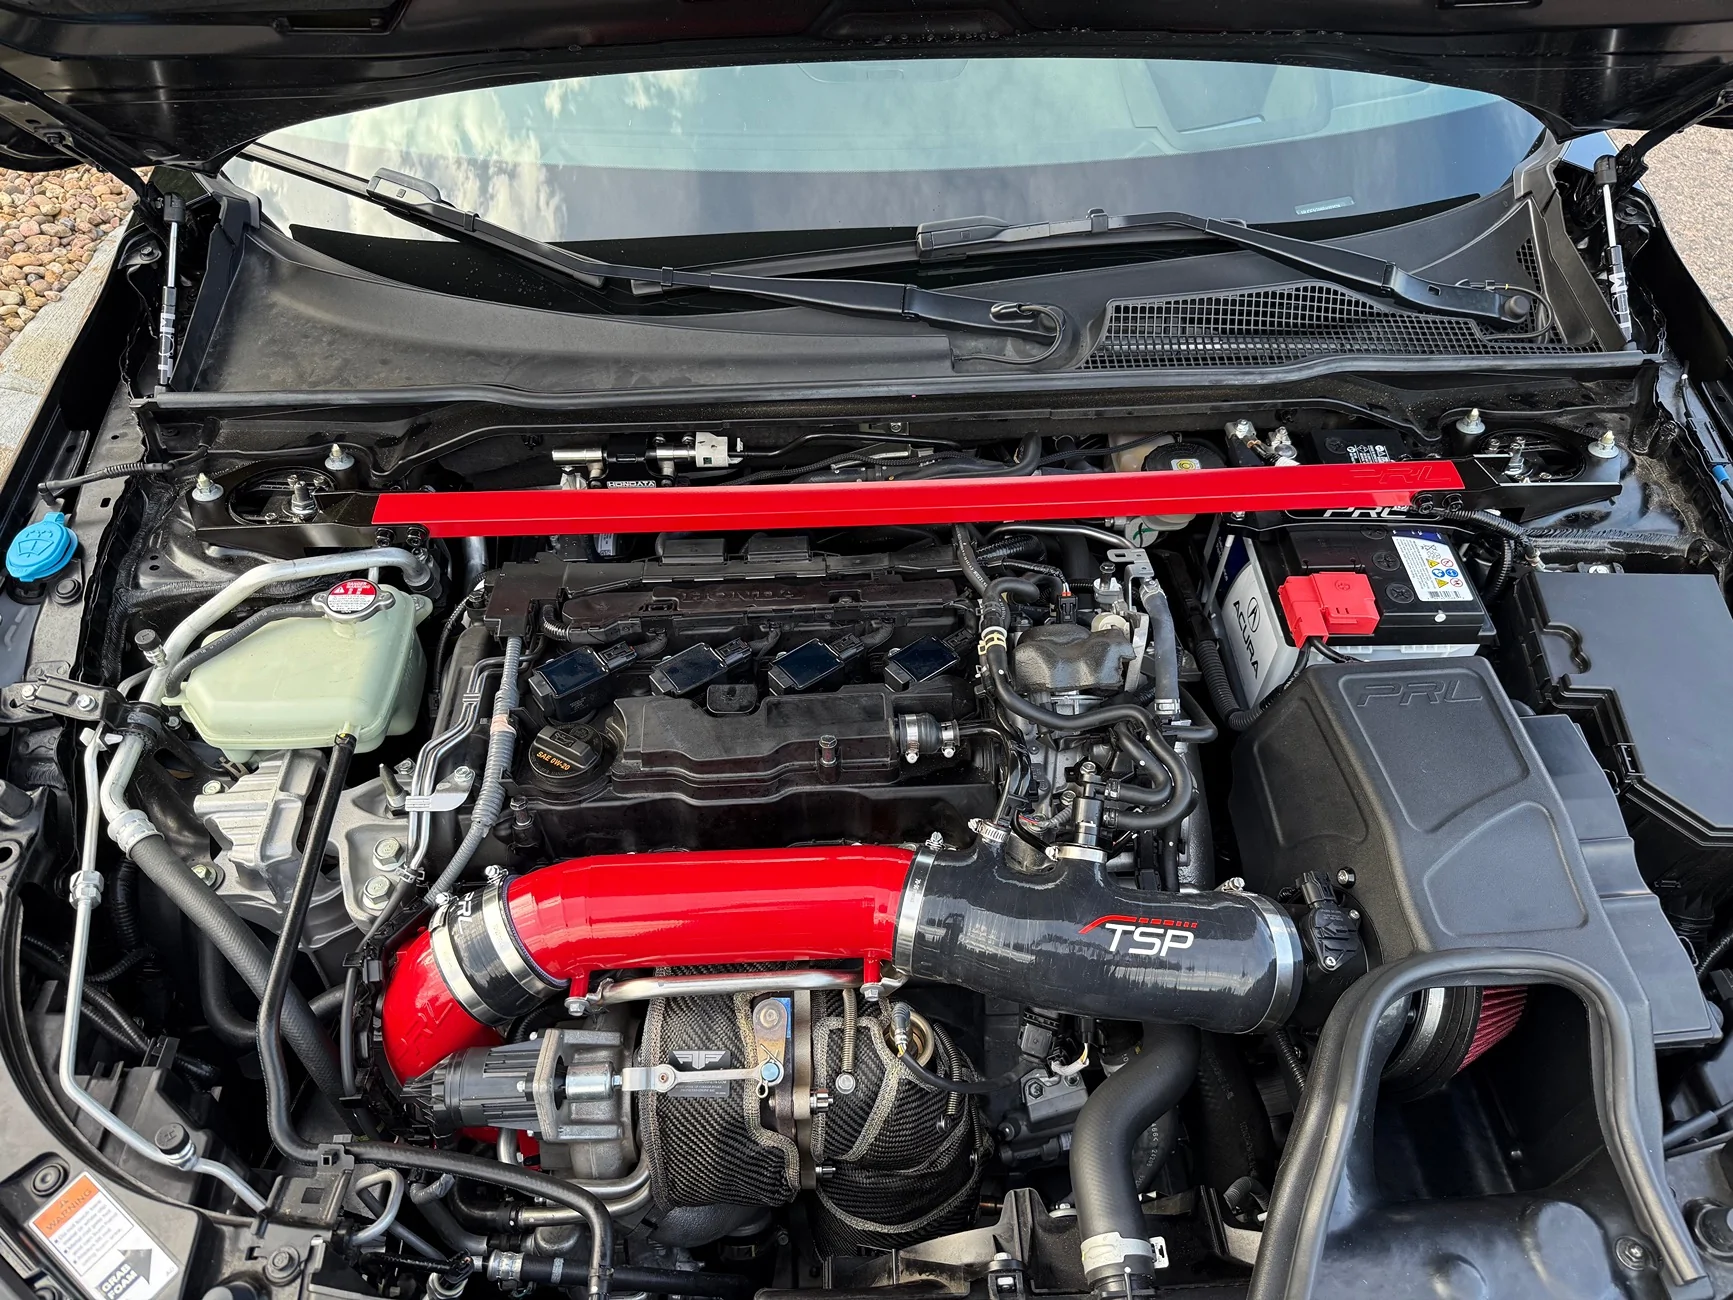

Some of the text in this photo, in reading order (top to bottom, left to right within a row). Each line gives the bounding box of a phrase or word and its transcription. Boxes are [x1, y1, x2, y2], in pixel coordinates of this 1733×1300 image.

[1350, 466, 1451, 484] PRL
[682, 589, 805, 603] HONDA
[1233, 600, 1259, 680] ACURA
[1357, 680, 1483, 707] PRL
[536, 751, 552, 762] SAE
[550, 758, 571, 771] 0W-20
[456, 892, 475, 935] PRL
[1105, 923, 1195, 957] TSP
[46, 1188, 92, 1230] WARNING
[101, 1263, 131, 1293] GRAB
[107, 1270, 138, 1300] FOAM
